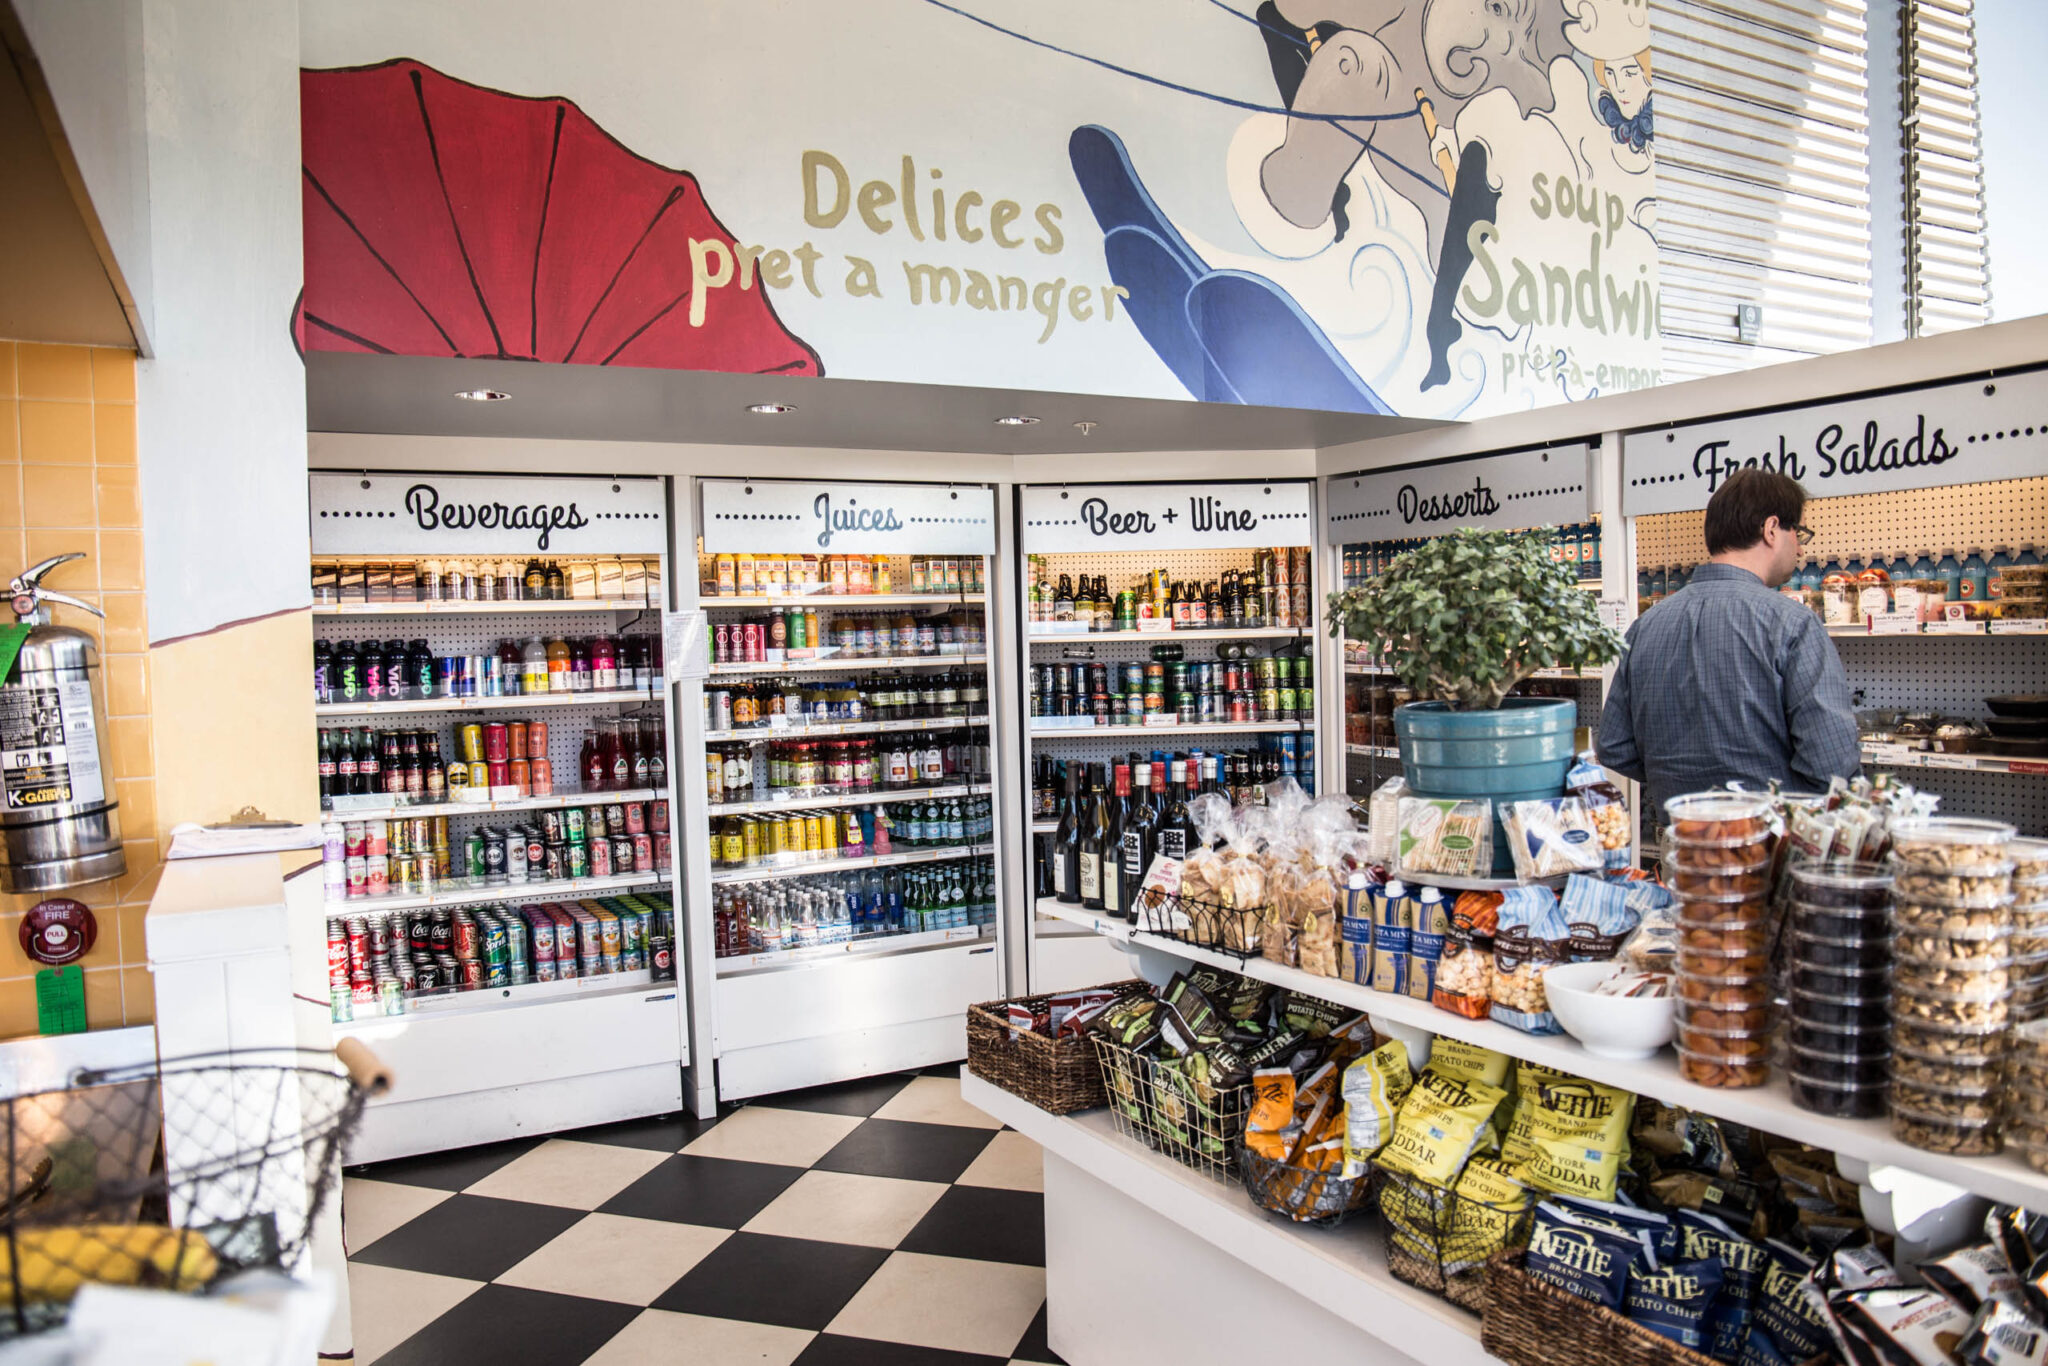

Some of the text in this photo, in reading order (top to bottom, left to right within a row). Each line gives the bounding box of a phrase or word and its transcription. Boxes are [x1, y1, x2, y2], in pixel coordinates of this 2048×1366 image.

[801, 149, 1066, 255] Delices
[1530, 171, 1625, 249] soup
[688, 237, 1130, 344] pret a manger
[1692, 414, 1959, 493] Fresh Salads
[1080, 496, 1257, 536] Beer + Wine
[1397, 476, 1500, 524] Desserts
[405, 484, 589, 550] Beverages
[813, 492, 904, 548] Juices
[45, 910, 70, 920] FIRE
[1287, 1003, 1340, 1026] POTATO CHIPS
[1448, 1044, 1471, 1056] BRAND
[1462, 1060, 1486, 1072] CHIPS
[1537, 1081, 1614, 1119] KETTLE
[1557, 1116, 1588, 1129] BRAND
[1394, 1132, 1438, 1165] DDAR
[1558, 1156, 1587, 1171] YORK
[1528, 1220, 1614, 1279] KETTLE
[1681, 1224, 1768, 1274] KETTLE
[1547, 1262, 1582, 1280] BRAND
[1566, 1280, 1602, 1303] CHIPS
[1630, 1296, 1664, 1312] TATO
[1754, 1307, 1783, 1332] TATO
[1767, 1301, 1801, 1326] BRAND
